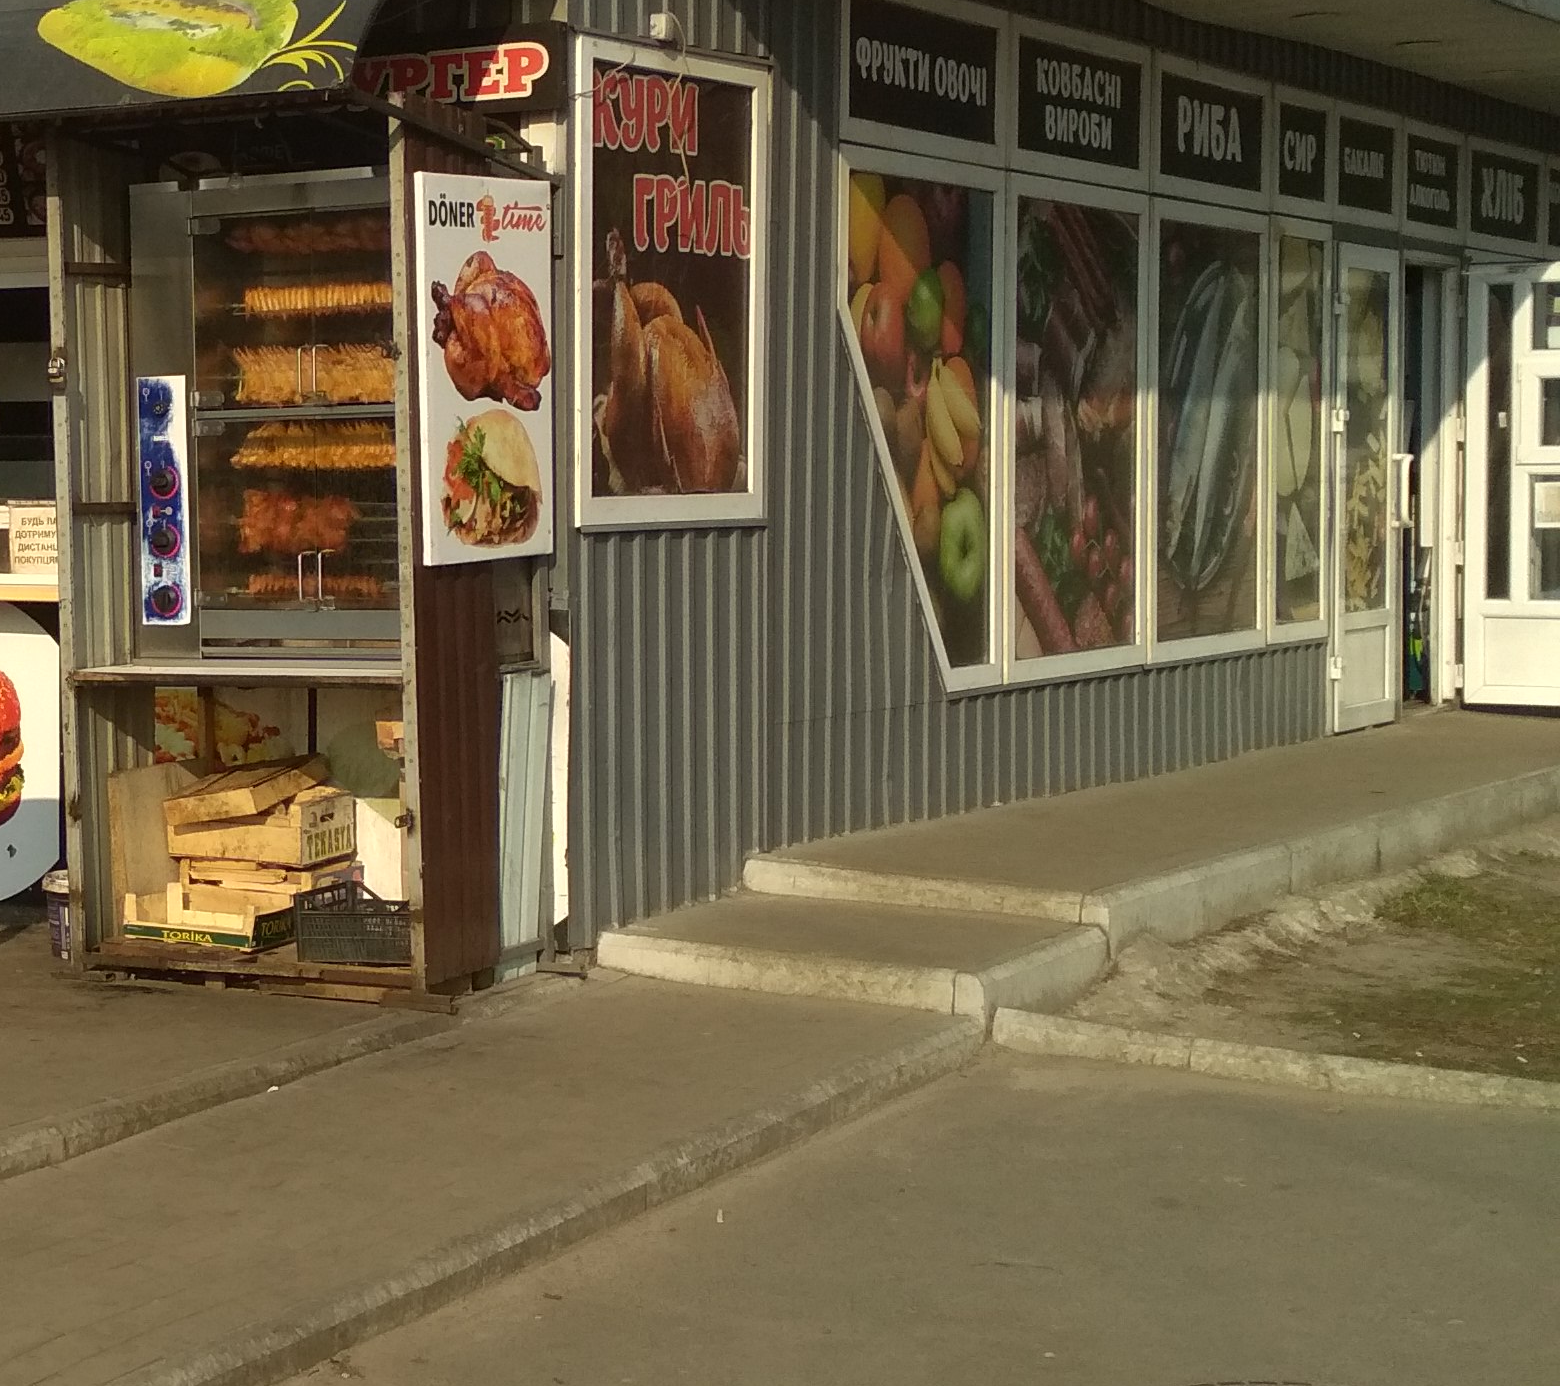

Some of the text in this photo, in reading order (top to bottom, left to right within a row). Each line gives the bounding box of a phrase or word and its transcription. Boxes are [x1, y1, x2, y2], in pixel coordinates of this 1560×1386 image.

[351, 43, 549, 103] УРГЕР
[856, 37, 987, 107] ФРУКТИ ОВОЧІ
[1036, 57, 1121, 109] КОВБАСНІ
[593, 69, 699, 156] КУРИ
[1045, 104, 1112, 151] ВИРОБИ
[1178, 95, 1242, 162] РИБА
[1283, 130, 1317, 173] СИР
[428, 193, 547, 232] DÖNER time
[633, 173, 750, 259] ГРИЛЬ
[1481, 168, 1524, 224] ХЛІБ
[15, 530, 55, 540] ДОТРИМУ
[21, 517, 44, 527] БУДЬ
